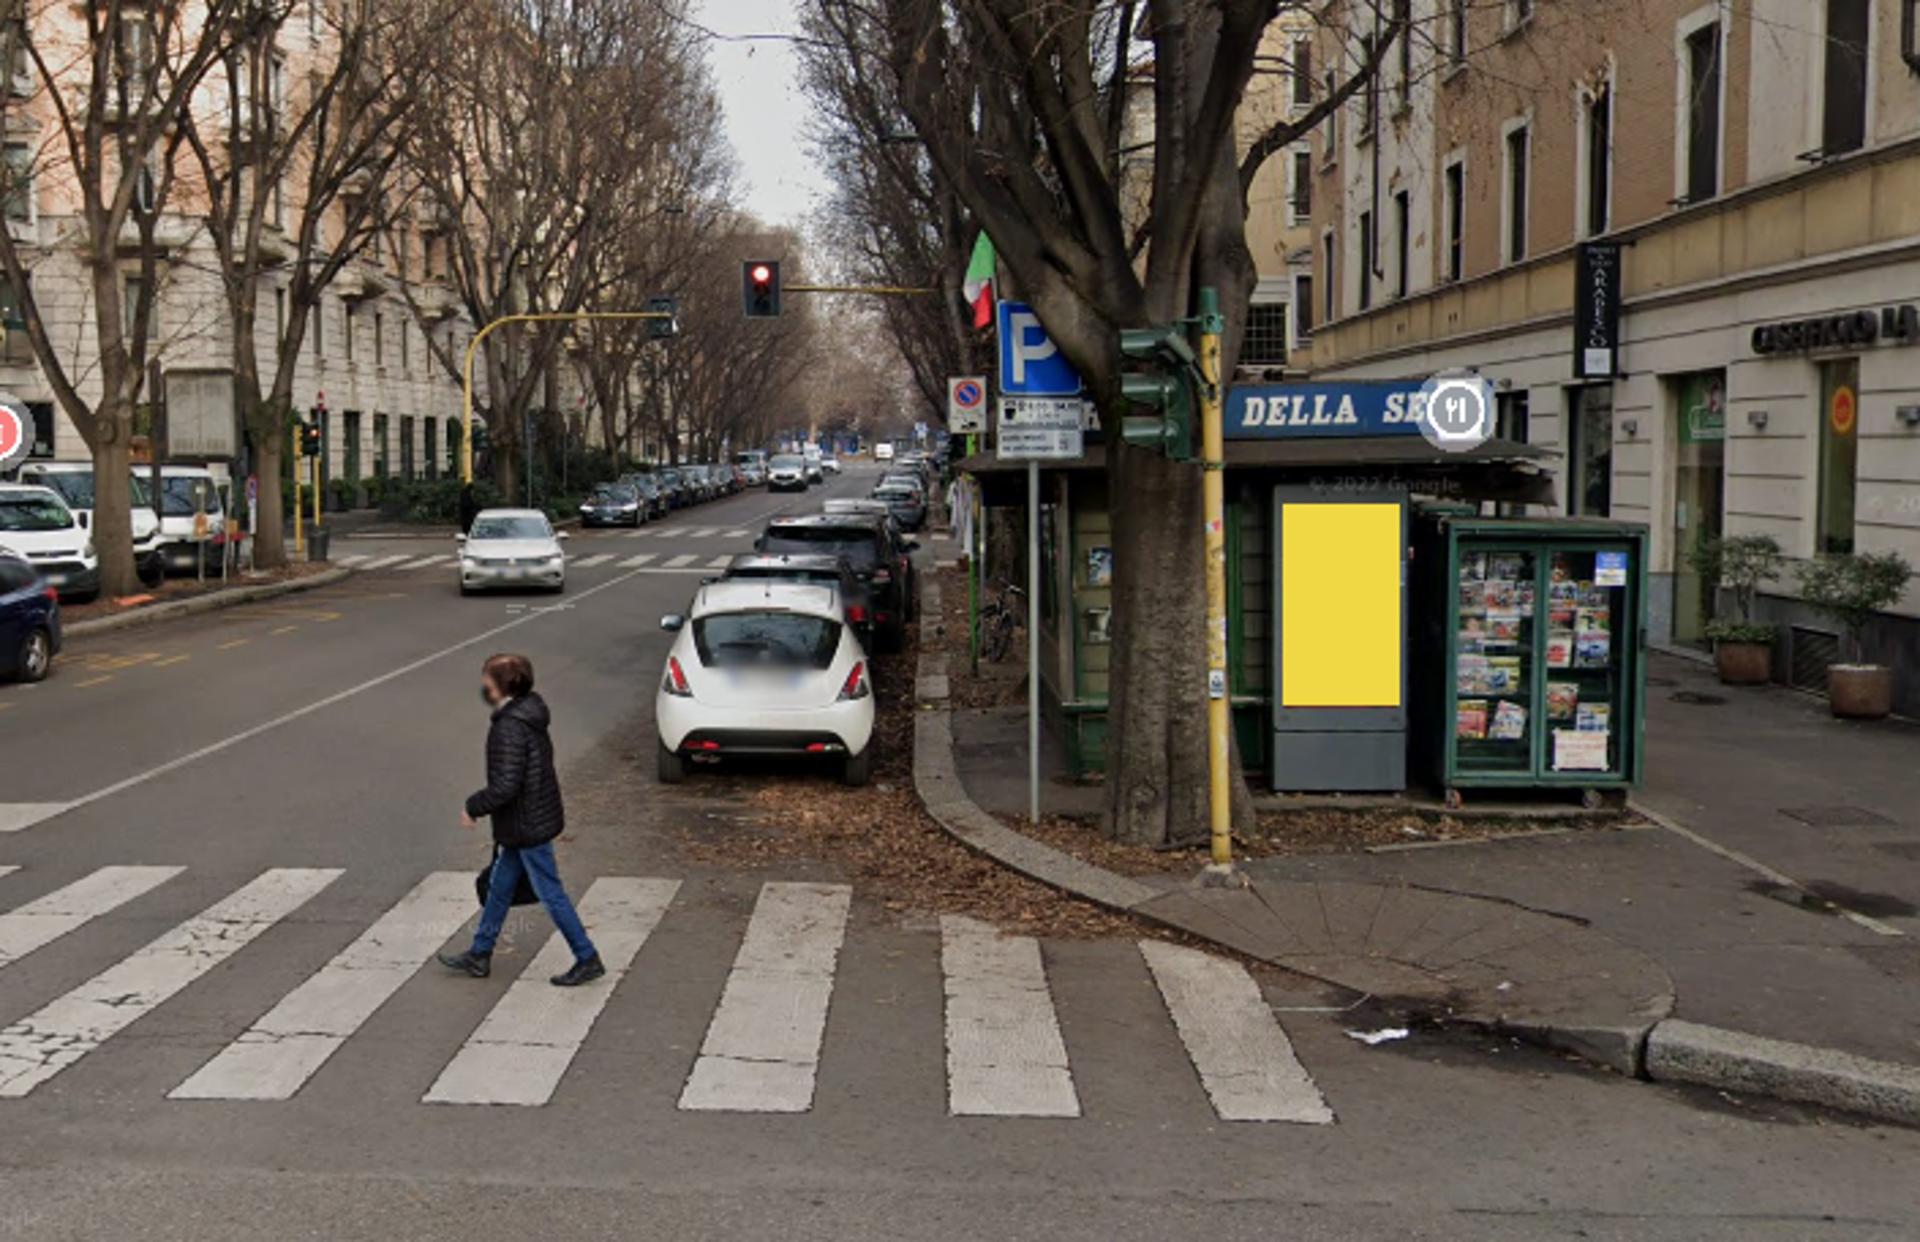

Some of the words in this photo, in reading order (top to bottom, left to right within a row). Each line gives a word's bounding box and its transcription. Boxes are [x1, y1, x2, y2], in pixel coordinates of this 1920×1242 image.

[1010, 312, 1057, 384] P
[1241, 394, 1358, 426] DELLA
[1382, 391, 1430, 423] SE
